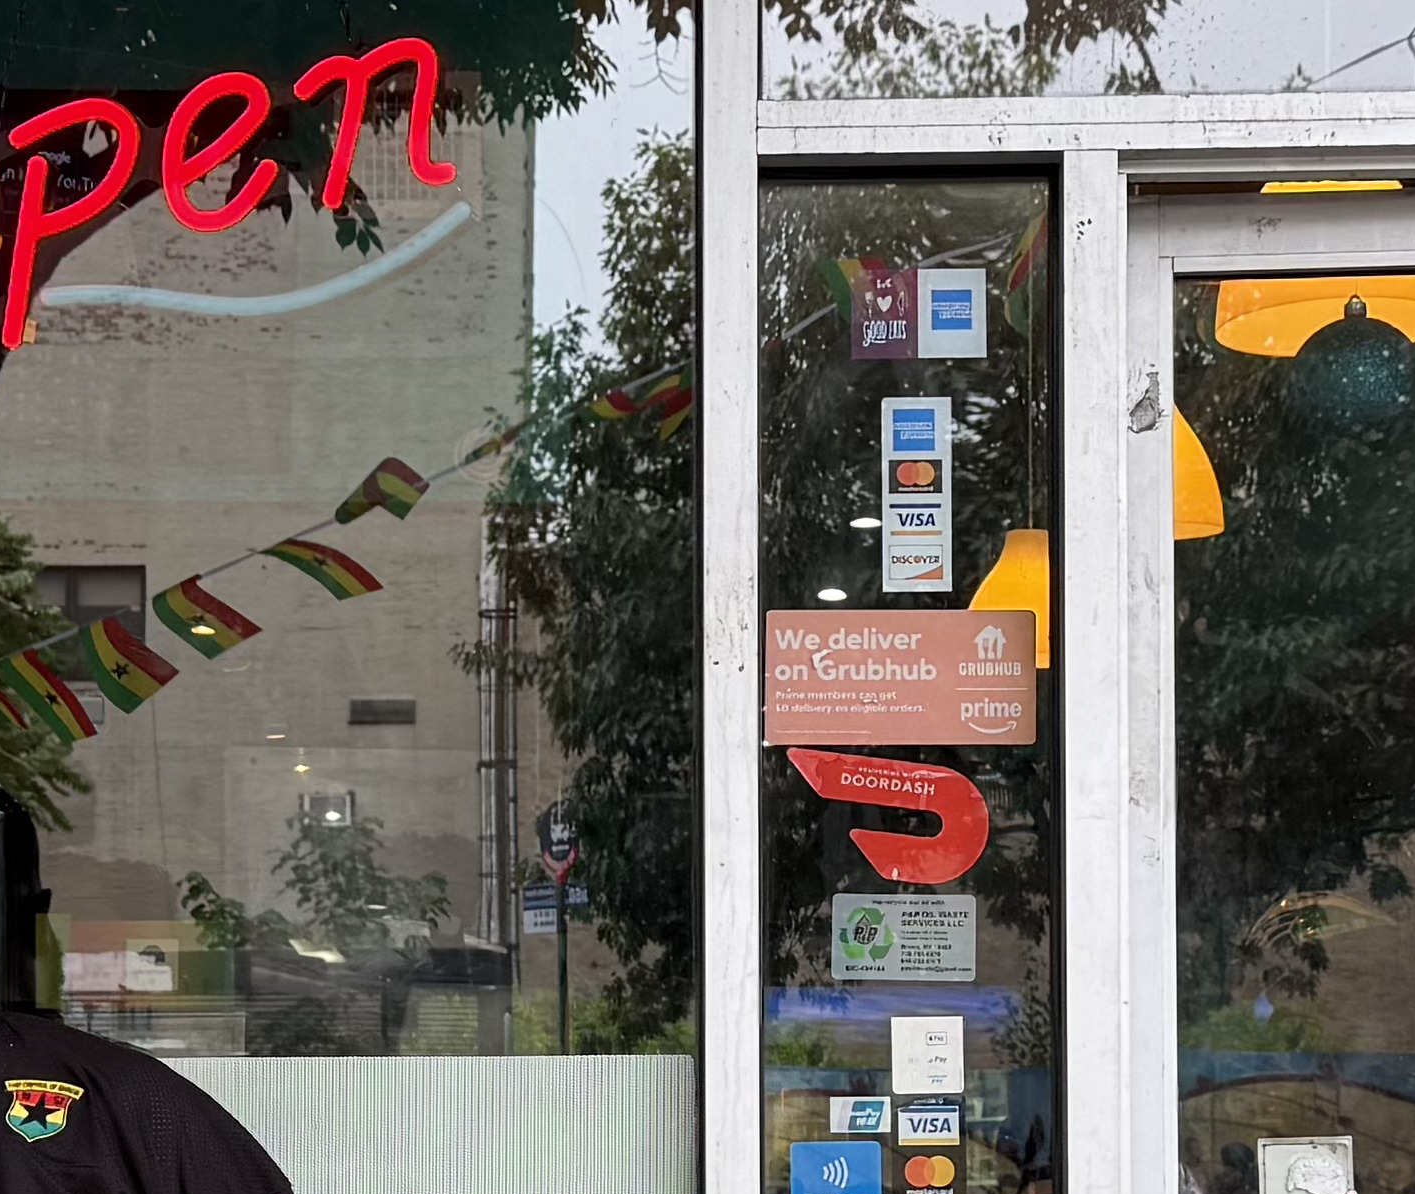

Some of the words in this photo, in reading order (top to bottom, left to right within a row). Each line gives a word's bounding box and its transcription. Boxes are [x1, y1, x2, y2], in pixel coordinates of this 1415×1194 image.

[896, 513, 936, 526] VISA
[891, 555, 940, 564] DISCOVER
[775, 629, 820, 650] We
[828, 628, 922, 650] deliver
[775, 663, 808, 681] on
[816, 657, 937, 681] Grubhub
[958, 662, 1022, 676] GRUBHUB
[960, 697, 1023, 721] prime
[841, 772, 936, 796] DOORDASH
[906, 1117, 952, 1133] VISA
